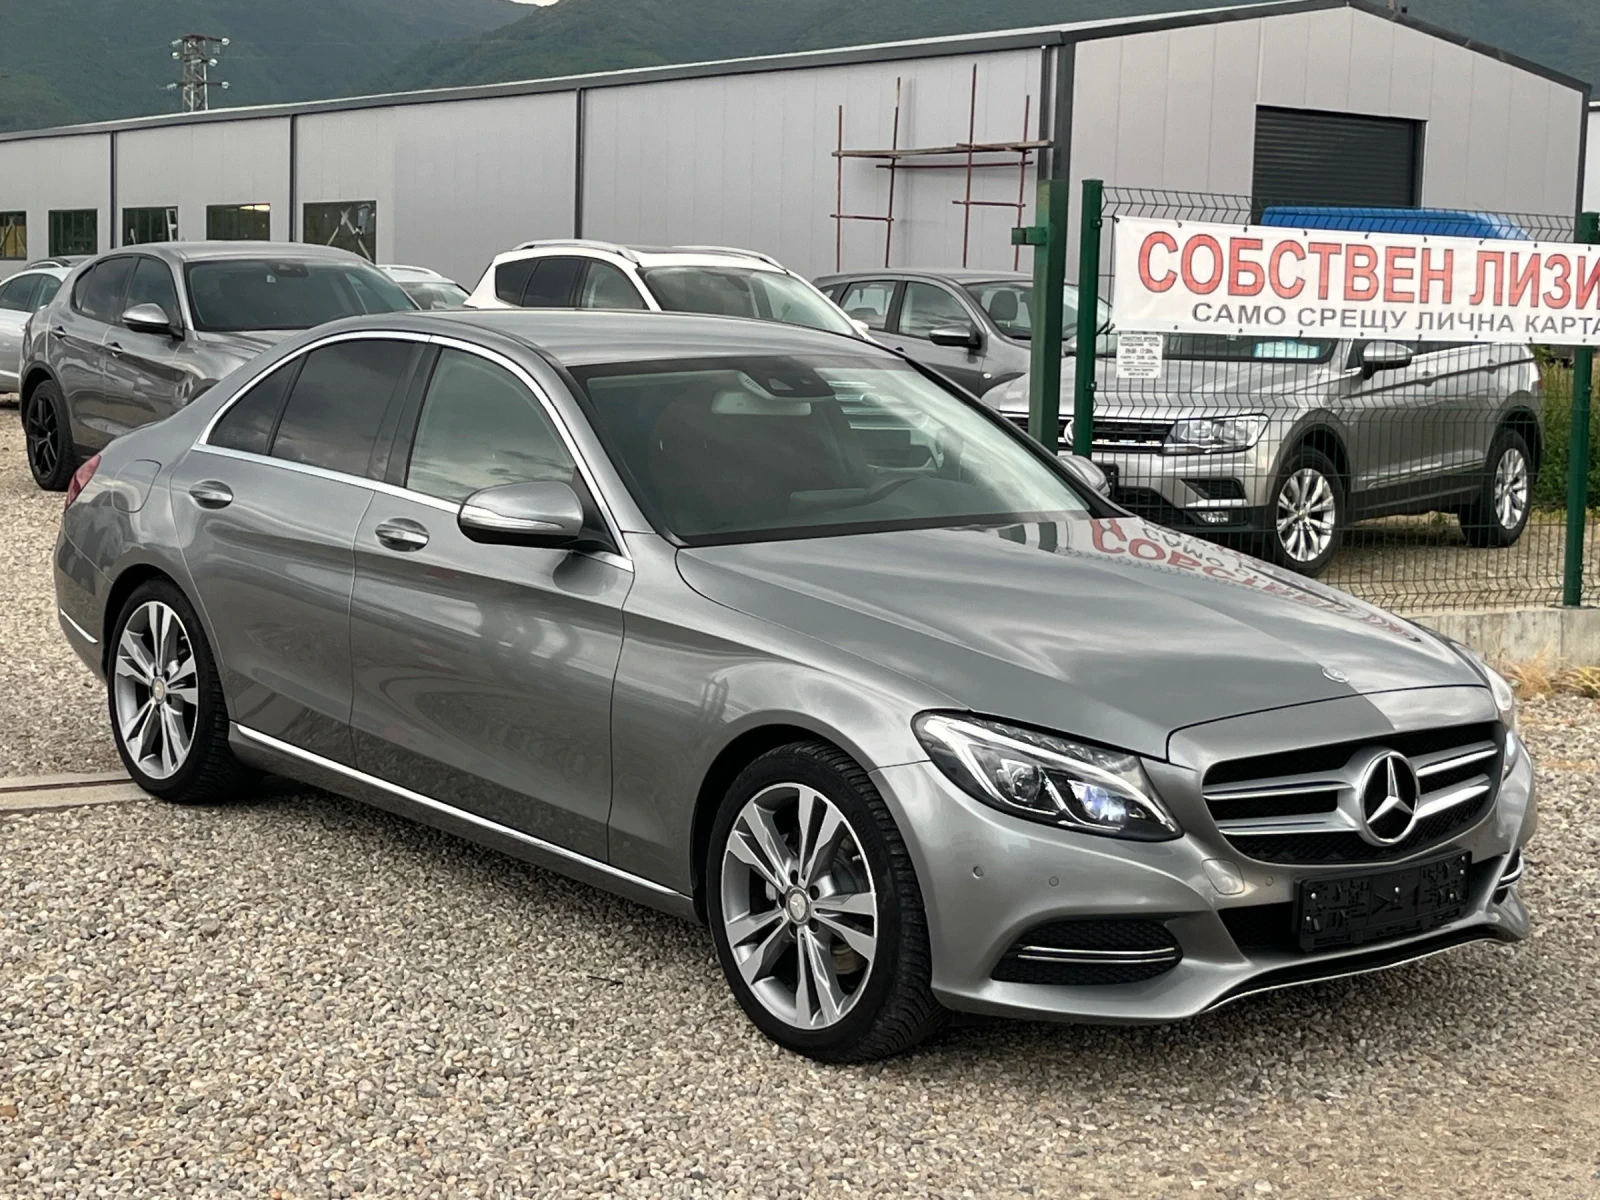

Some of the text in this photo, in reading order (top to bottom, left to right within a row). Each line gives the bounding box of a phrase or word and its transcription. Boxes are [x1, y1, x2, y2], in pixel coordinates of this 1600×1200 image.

[1138, 231, 1454, 305] СОБСТВЕН
[1192, 303, 1286, 325] САМО
[1297, 308, 1407, 333] СРЕЩУ
[1416, 311, 1514, 332] ЛИЧНА
